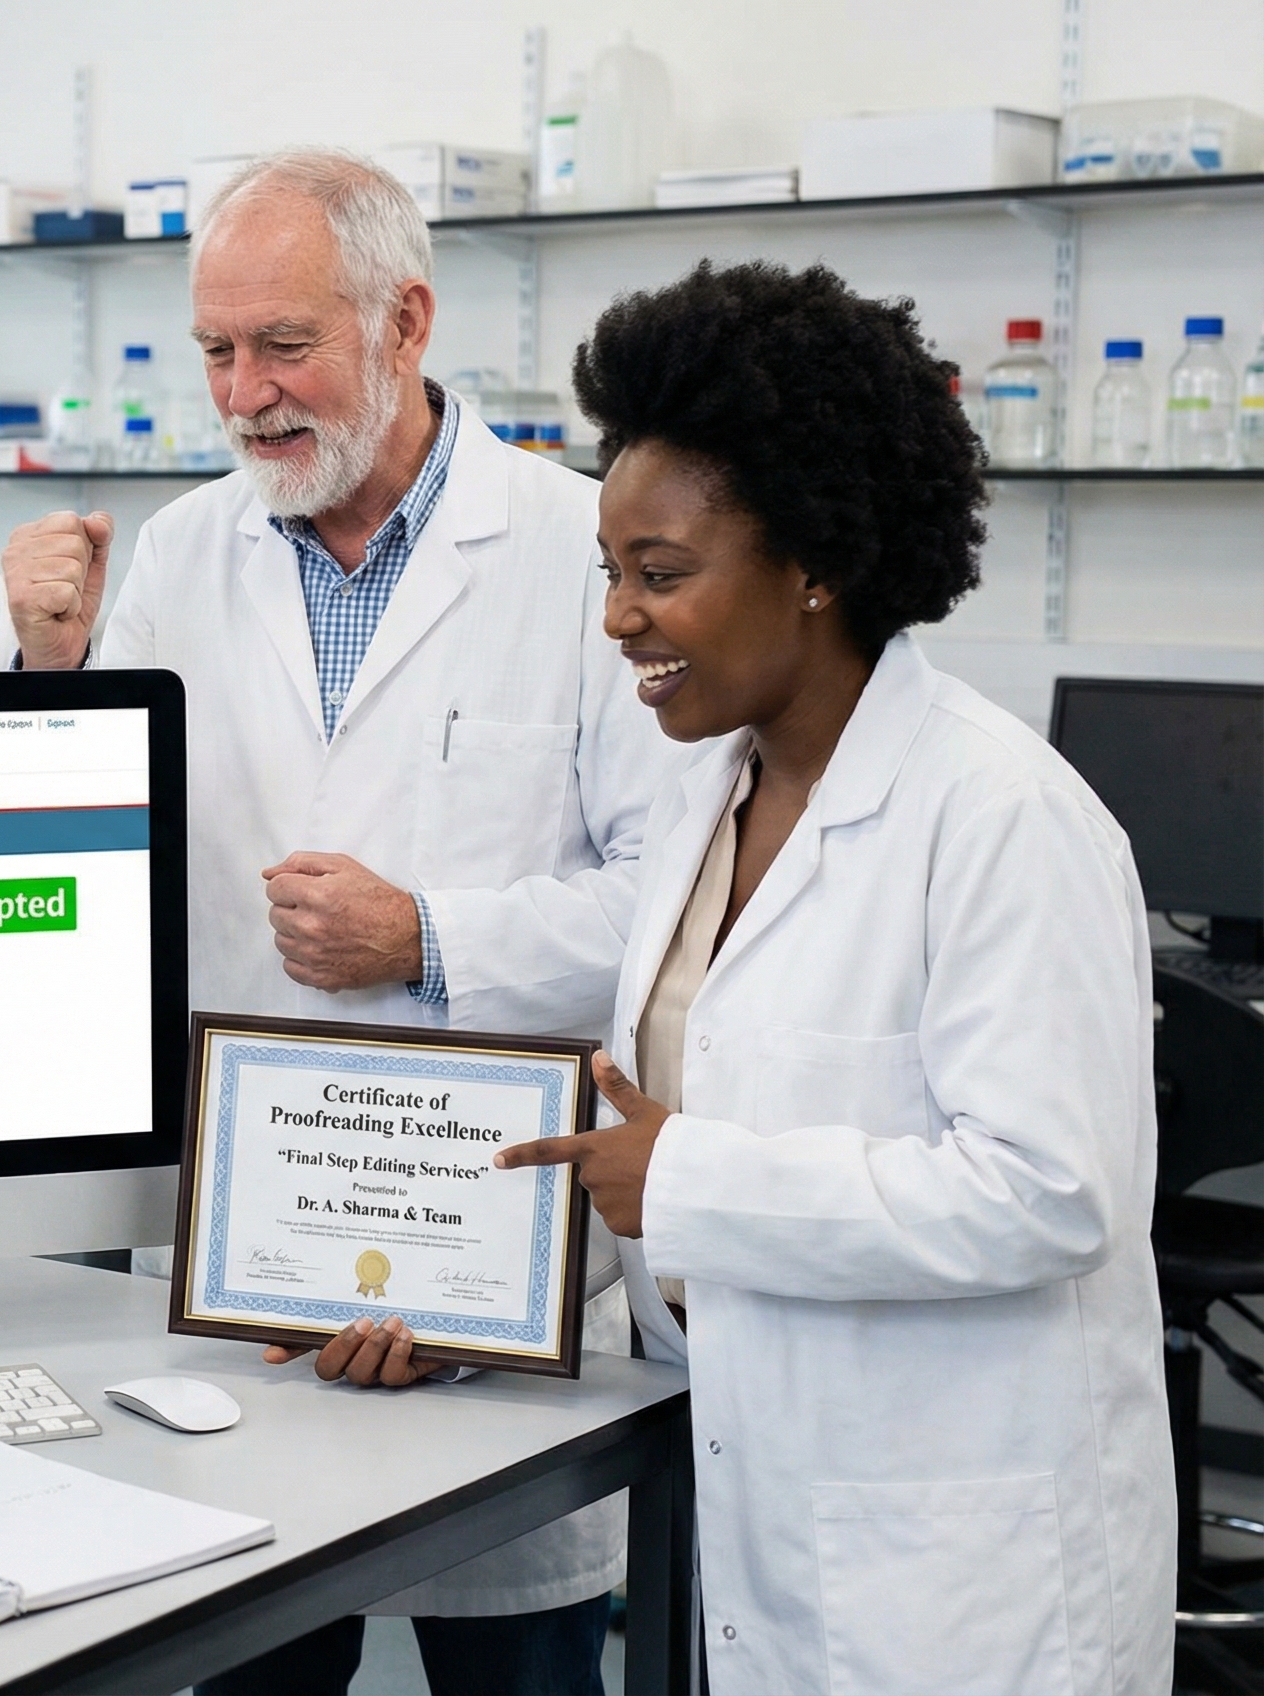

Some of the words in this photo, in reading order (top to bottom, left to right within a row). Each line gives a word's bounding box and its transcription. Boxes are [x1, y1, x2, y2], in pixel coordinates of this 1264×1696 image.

[323, 1084, 424, 1110] Certificate
[428, 1093, 450, 1111] of
[270, 1106, 394, 1138] Proofreading
[400, 1117, 502, 1143] Excellence
[327, 1152, 357, 1172] Step
[362, 1156, 416, 1178] Editing
[297, 1196, 319, 1211] Dr.
[322, 1199, 338, 1213] A.
[342, 1200, 399, 1219] Sharma
[404, 1206, 418, 1221] &
[422, 1208, 462, 1226] Team
